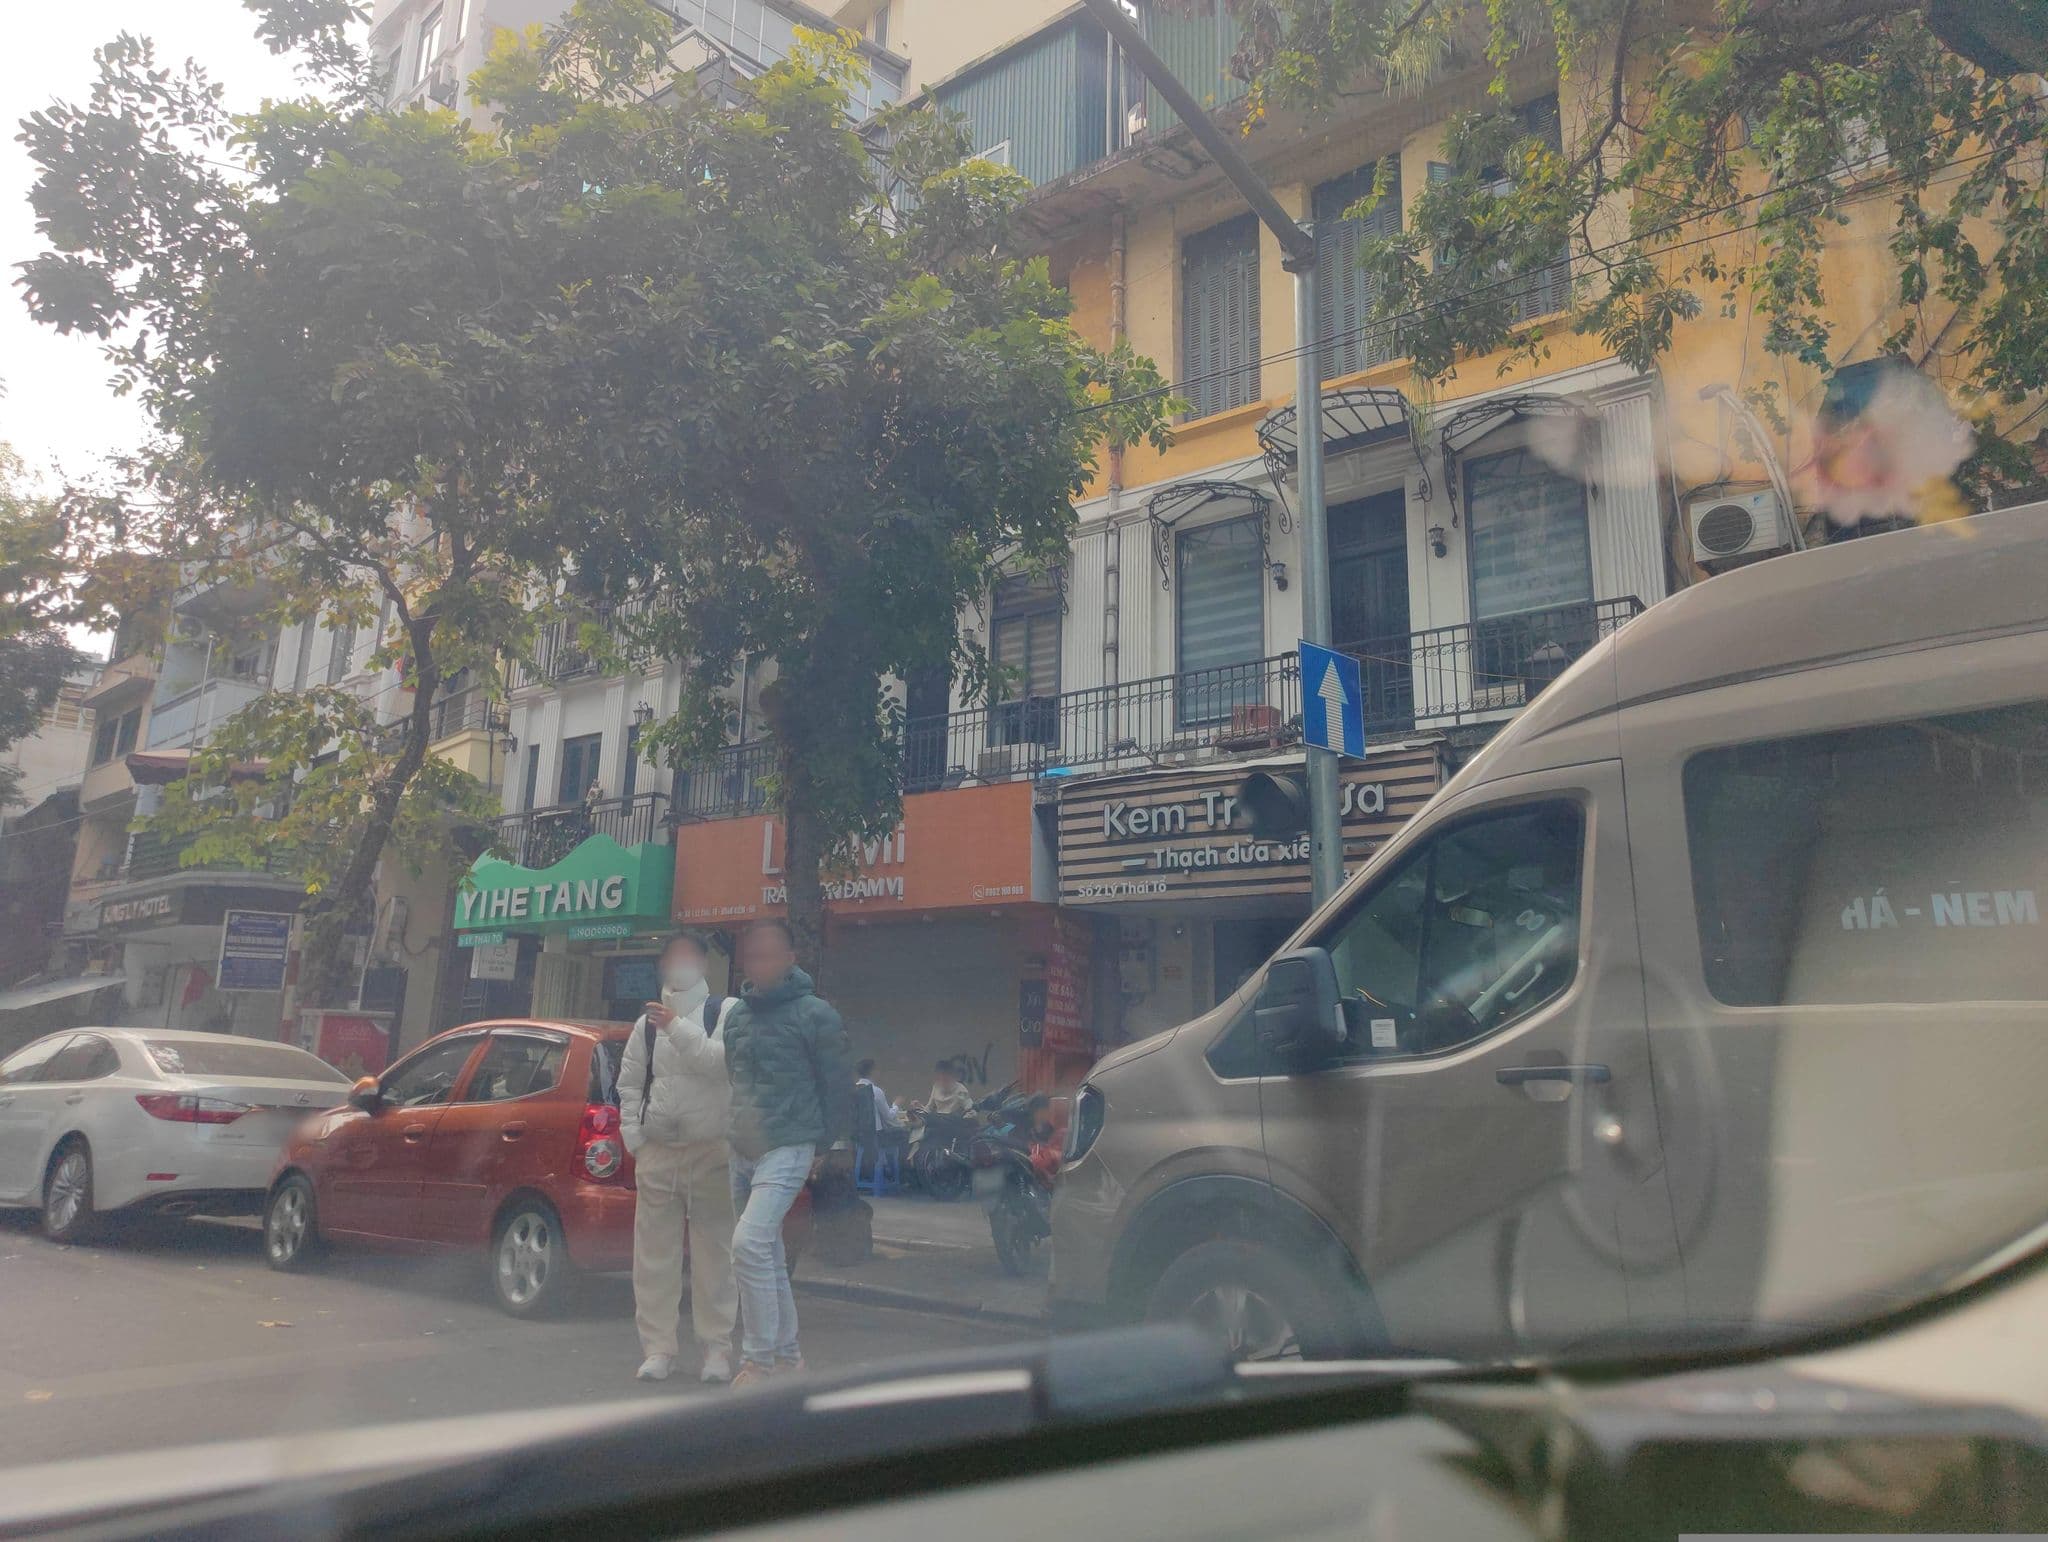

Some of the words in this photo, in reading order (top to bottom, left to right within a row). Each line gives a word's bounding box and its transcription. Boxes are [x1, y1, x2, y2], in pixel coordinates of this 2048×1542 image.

[1104, 802, 1185, 837] Kem
[1154, 844, 1219, 876] Thạch
[1279, 836, 1310, 861] xiê
[843, 875, 884, 904] ĐẬM
[886, 876, 904, 901] VỊ
[1094, 884, 1102, 897] 2
[1104, 882, 1118, 898] Lý
[1120, 880, 1149, 895] Thái
[1151, 875, 1167, 893] Tổ
[1931, 889, 2040, 927] NEM
